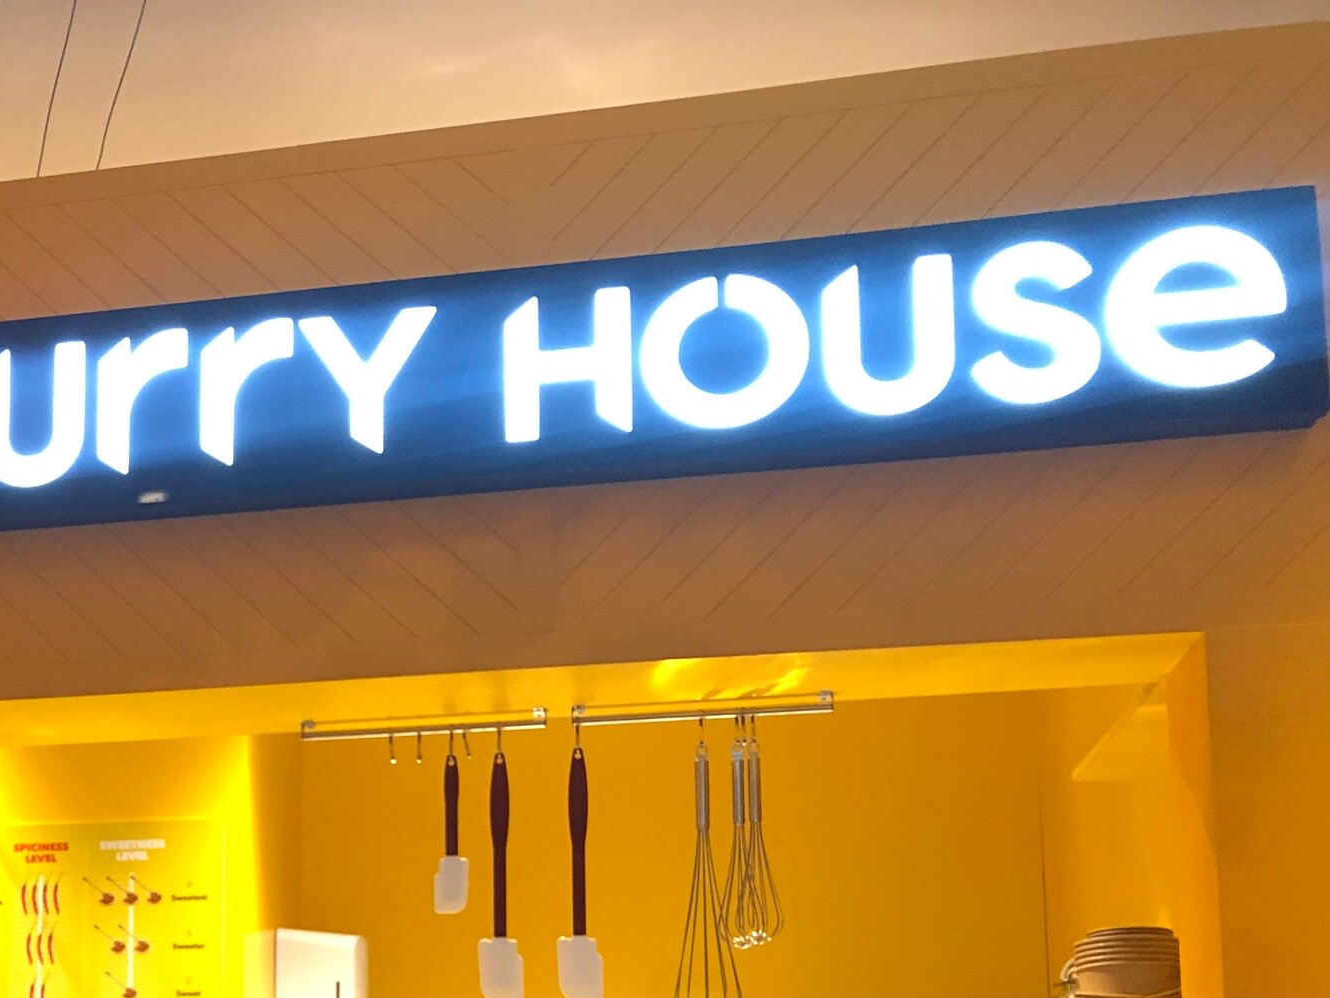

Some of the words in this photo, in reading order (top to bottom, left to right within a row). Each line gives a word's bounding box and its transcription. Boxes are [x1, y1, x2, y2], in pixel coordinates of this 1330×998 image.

[14, 842, 69, 852] SPICINESS
[99, 838, 166, 850] SWEETNESS
[25, 854, 57, 863] LEVEL
[116, 850, 149, 861] LEVEL
